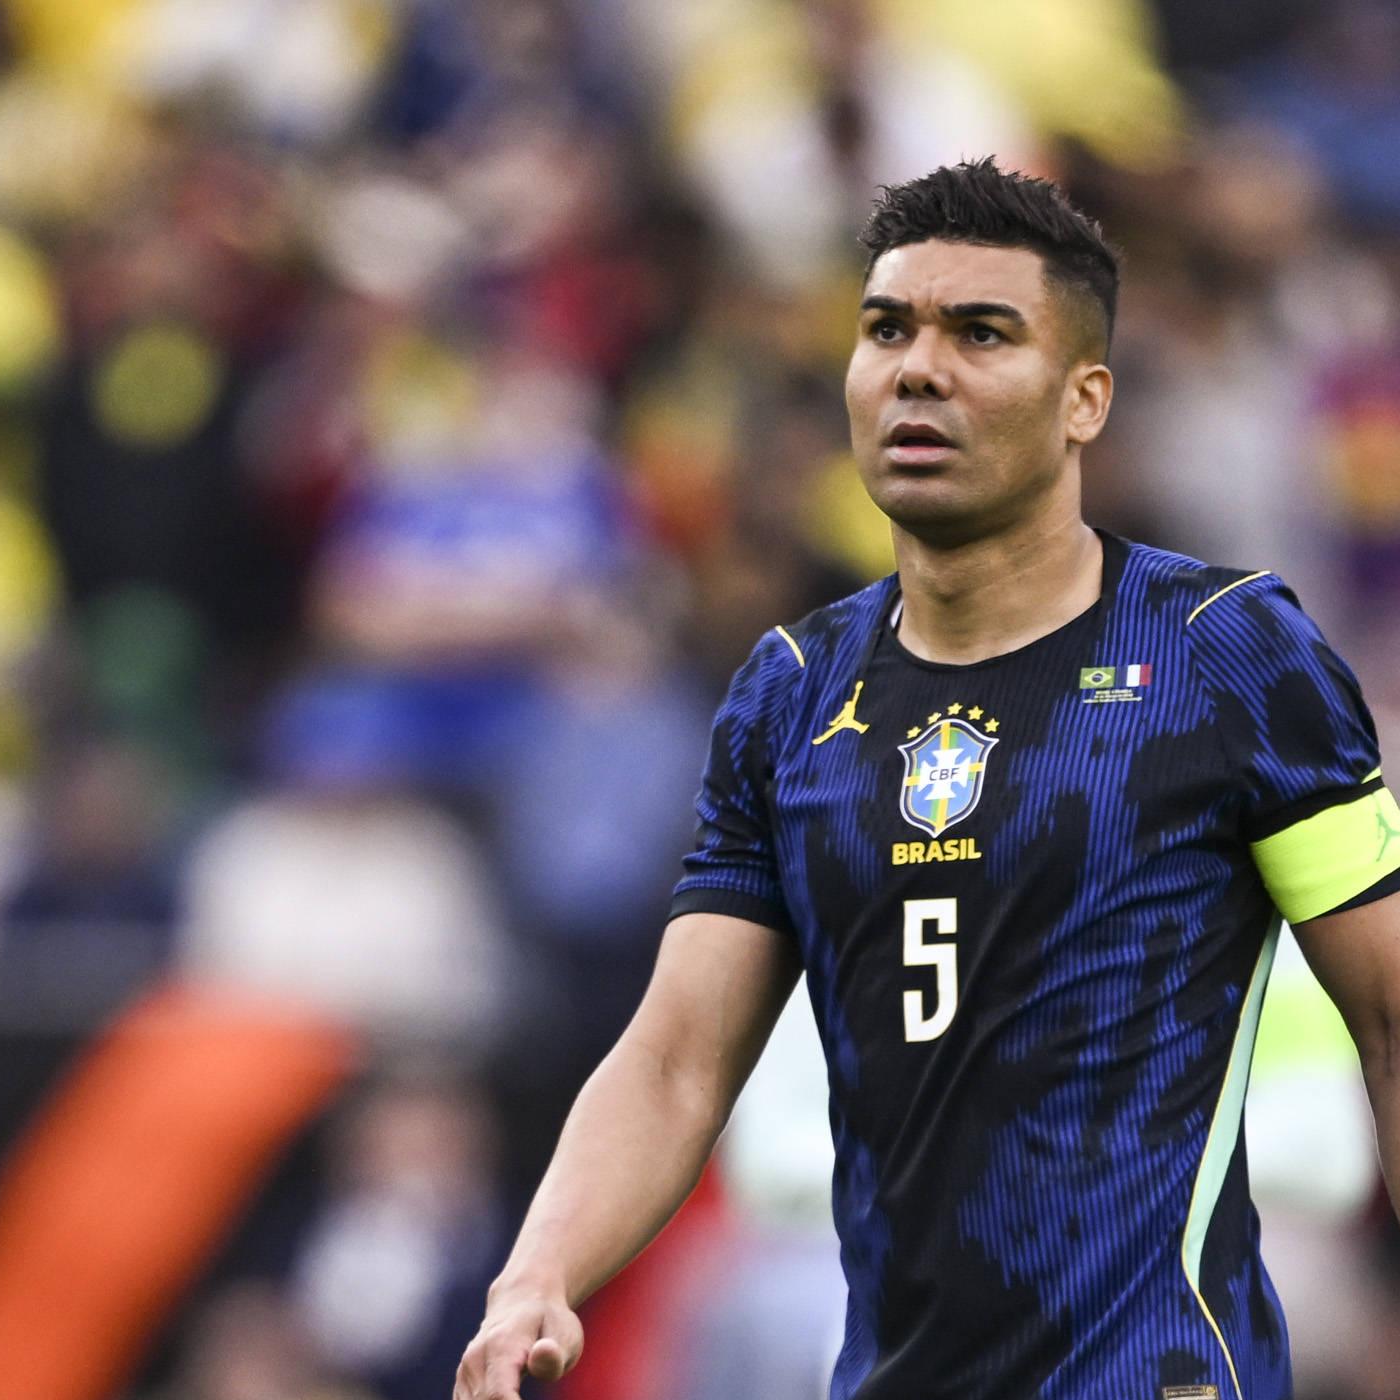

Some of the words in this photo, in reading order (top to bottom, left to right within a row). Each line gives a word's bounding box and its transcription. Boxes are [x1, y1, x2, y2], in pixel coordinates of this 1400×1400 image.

[928, 767, 961, 782] CBF
[891, 837, 983, 866] BRASIL
[902, 897, 959, 1043] 5
